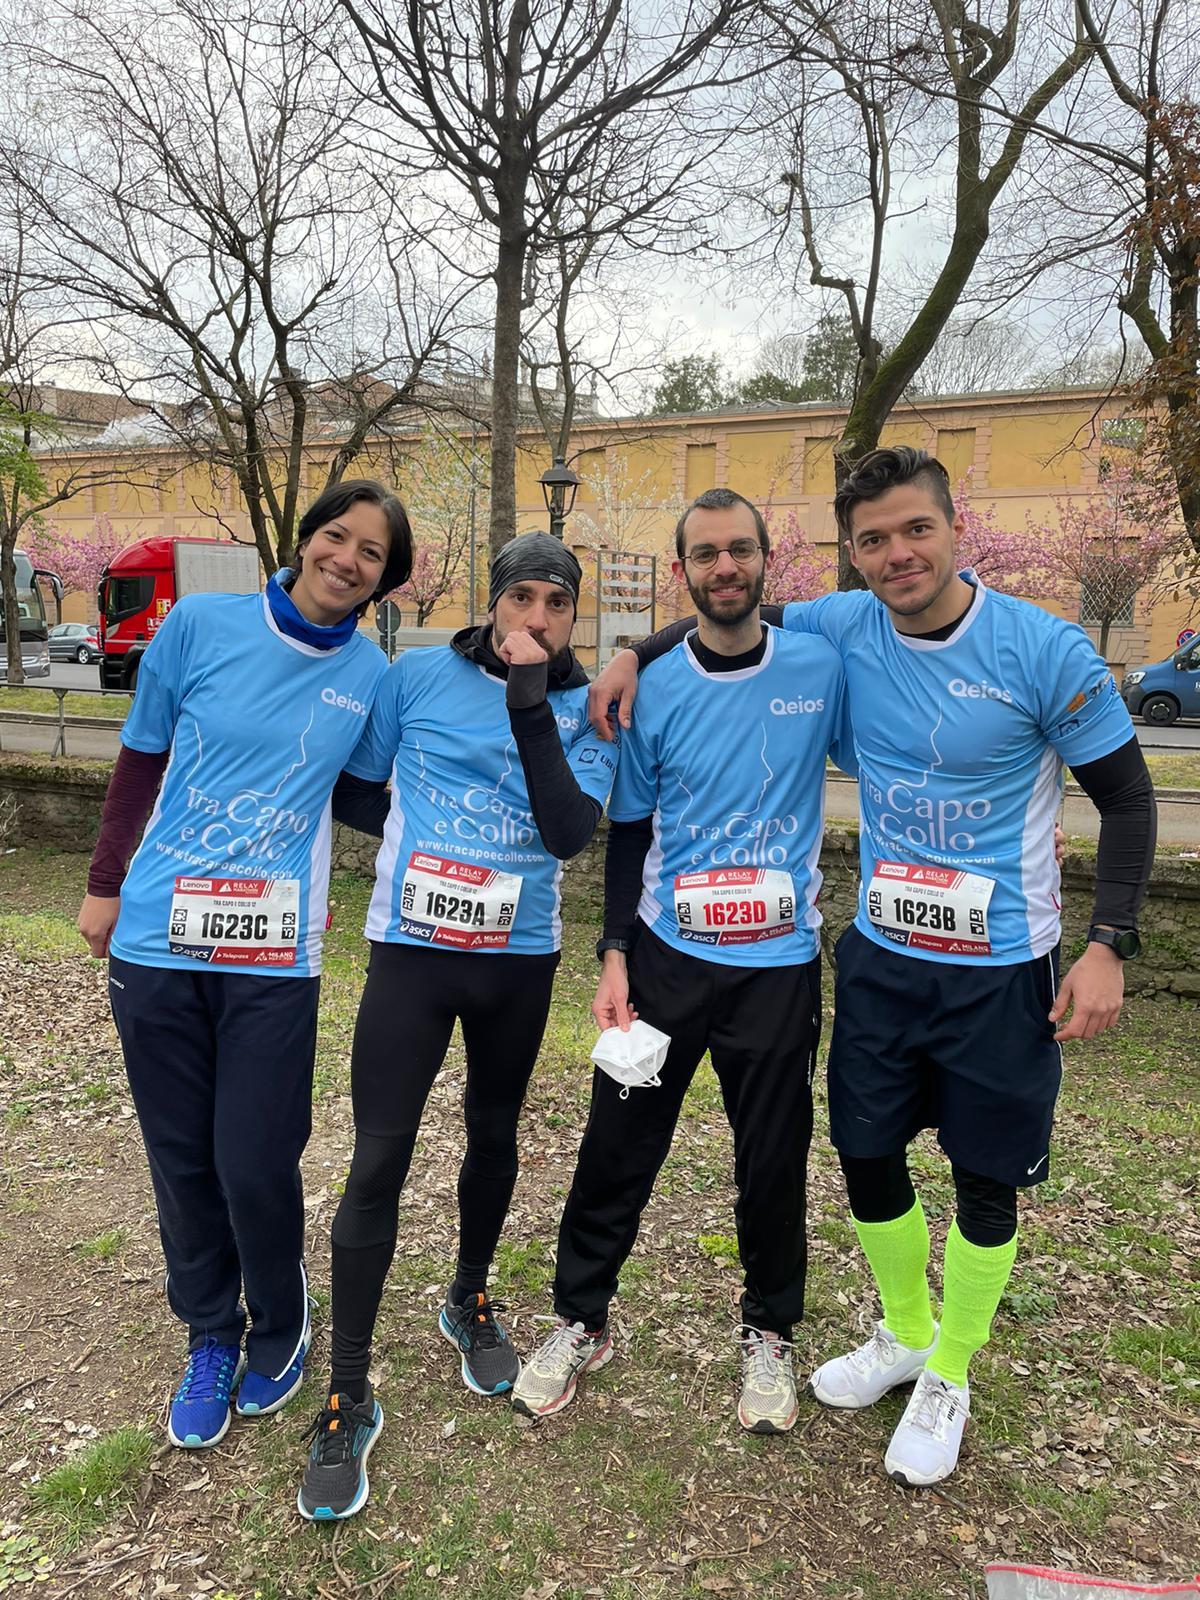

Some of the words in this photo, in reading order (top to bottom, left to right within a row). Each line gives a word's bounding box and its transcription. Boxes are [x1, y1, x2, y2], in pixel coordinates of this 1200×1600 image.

[321, 687, 366, 716] Qeios
[948, 678, 1013, 703] Qeios
[770, 696, 825, 716] Qeios
[555, 713, 579, 731] ios
[861, 772, 882, 804] Tra
[887, 783, 992, 822] Capo
[187, 786, 220, 815] Tra
[227, 793, 309, 836] Capo
[434, 819, 448, 834] e
[453, 815, 535, 847] Collo
[686, 824, 721, 841] Tra
[724, 815, 799, 842] Capo
[879, 812, 976, 852] Collo
[180, 826, 195, 842] e
[200, 823, 287, 862] Collo
[416, 840, 545, 863] www.tracapoecollo.com
[691, 852, 704, 866] e
[710, 840, 788, 867] Collo
[416, 856, 440, 869] Lenovo
[459, 866, 483, 877] RELAY
[881, 865, 906, 875] Lenovo
[925, 870, 950, 879] RELAY
[182, 881, 210, 889] Lenovo
[426, 891, 485, 926] 1623A
[703, 900, 767, 926] 1623D
[893, 897, 956, 931] 1623B
[201, 912, 268, 940] 1623C
